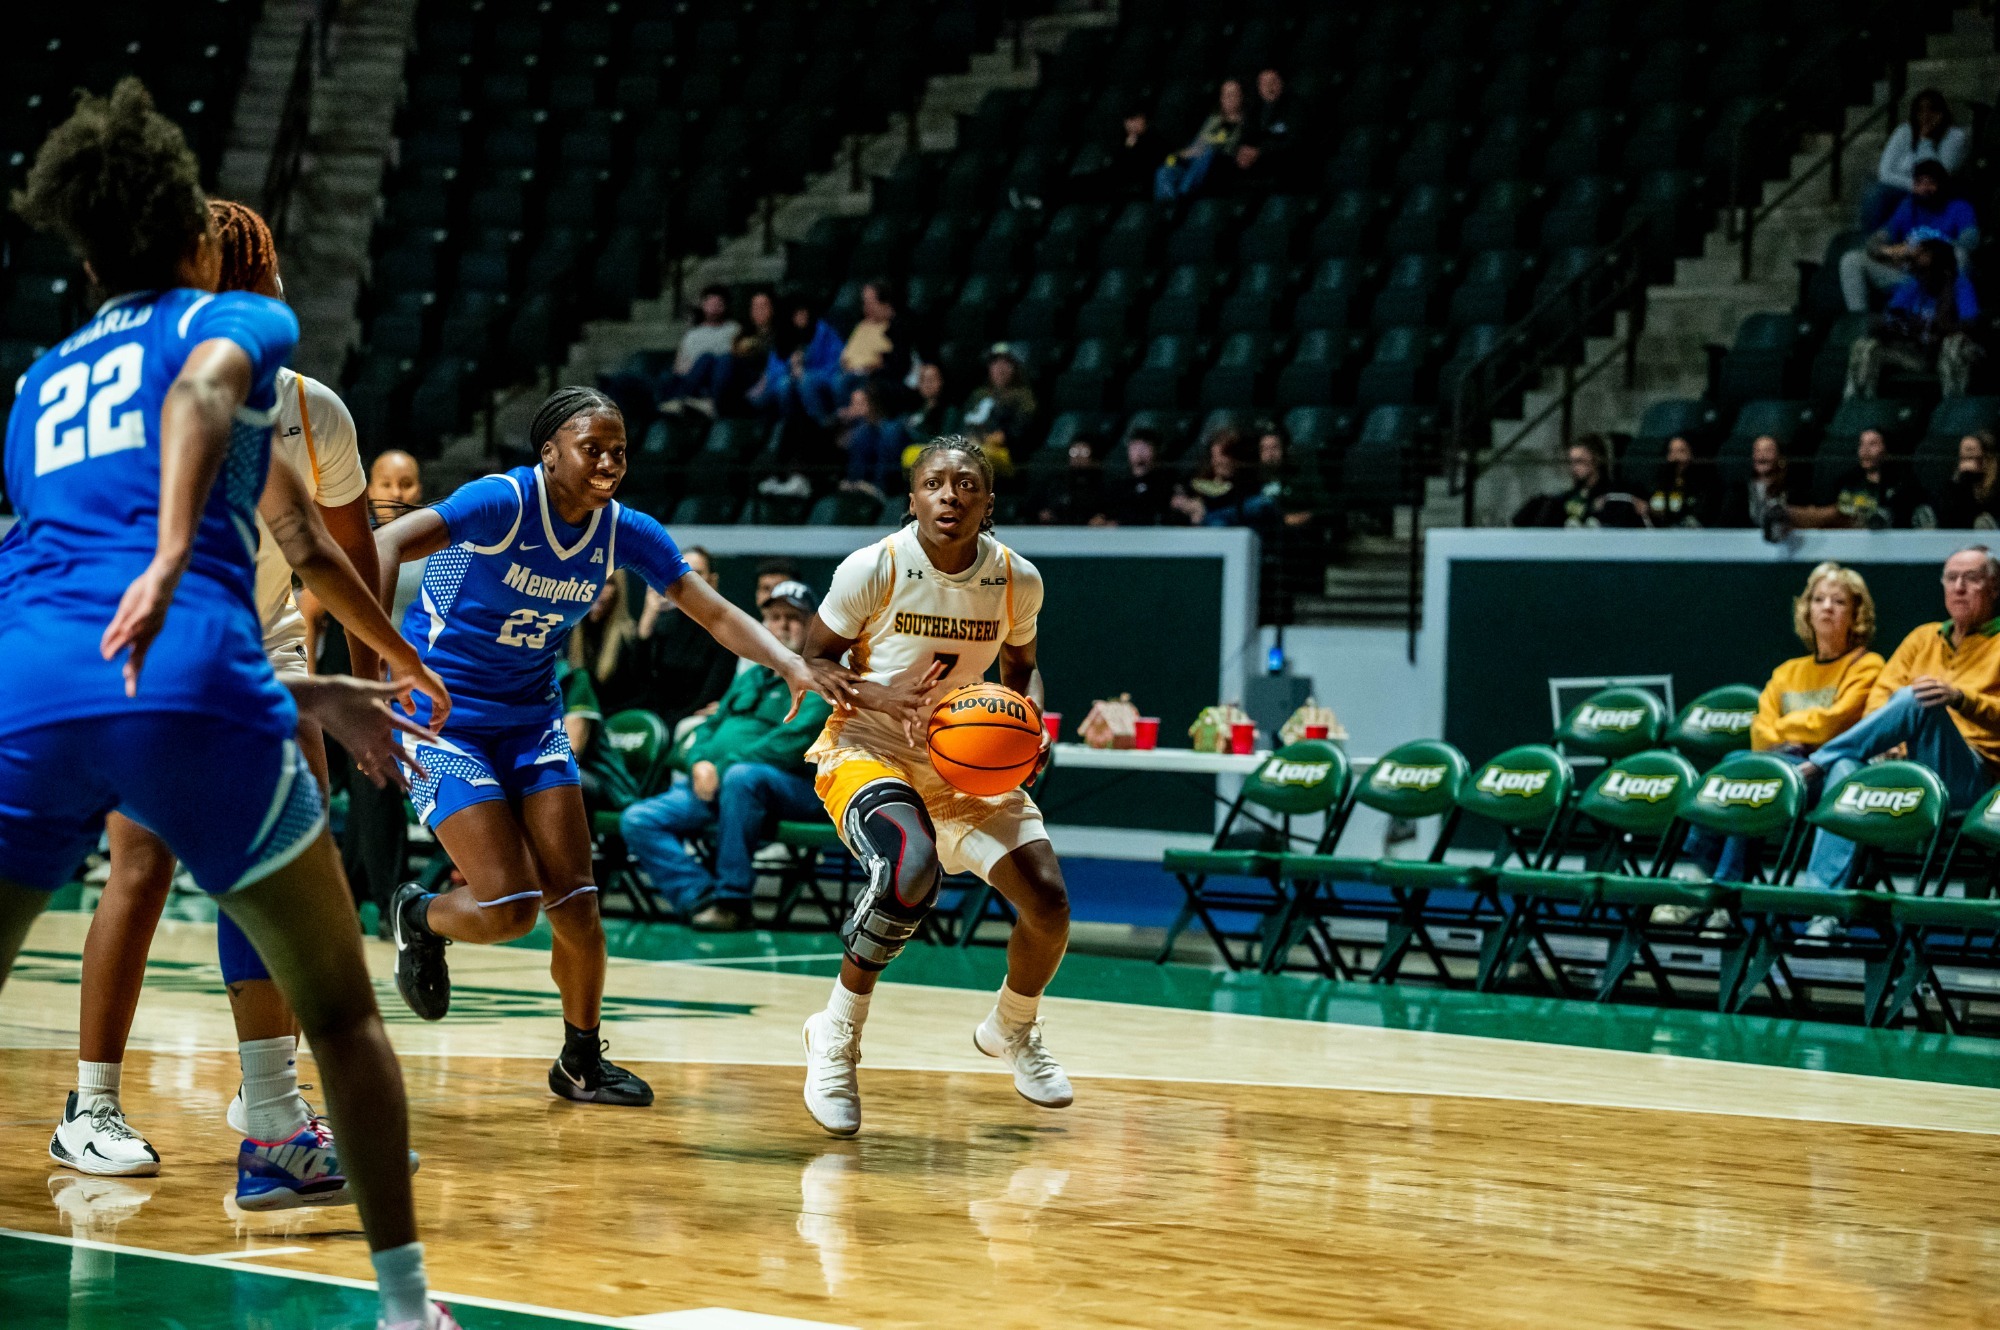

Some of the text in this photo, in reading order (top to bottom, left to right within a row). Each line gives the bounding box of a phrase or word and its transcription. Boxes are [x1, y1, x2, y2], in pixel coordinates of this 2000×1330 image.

[35, 341, 147, 477] 22
[589, 547, 604, 564] A
[501, 562, 597, 604] Memphis
[496, 608, 564, 649] 23
[894, 612, 1000, 642] SOUTHEASTERN
[933, 652, 960, 680] 7
[949, 697, 1028, 724] Wilson
